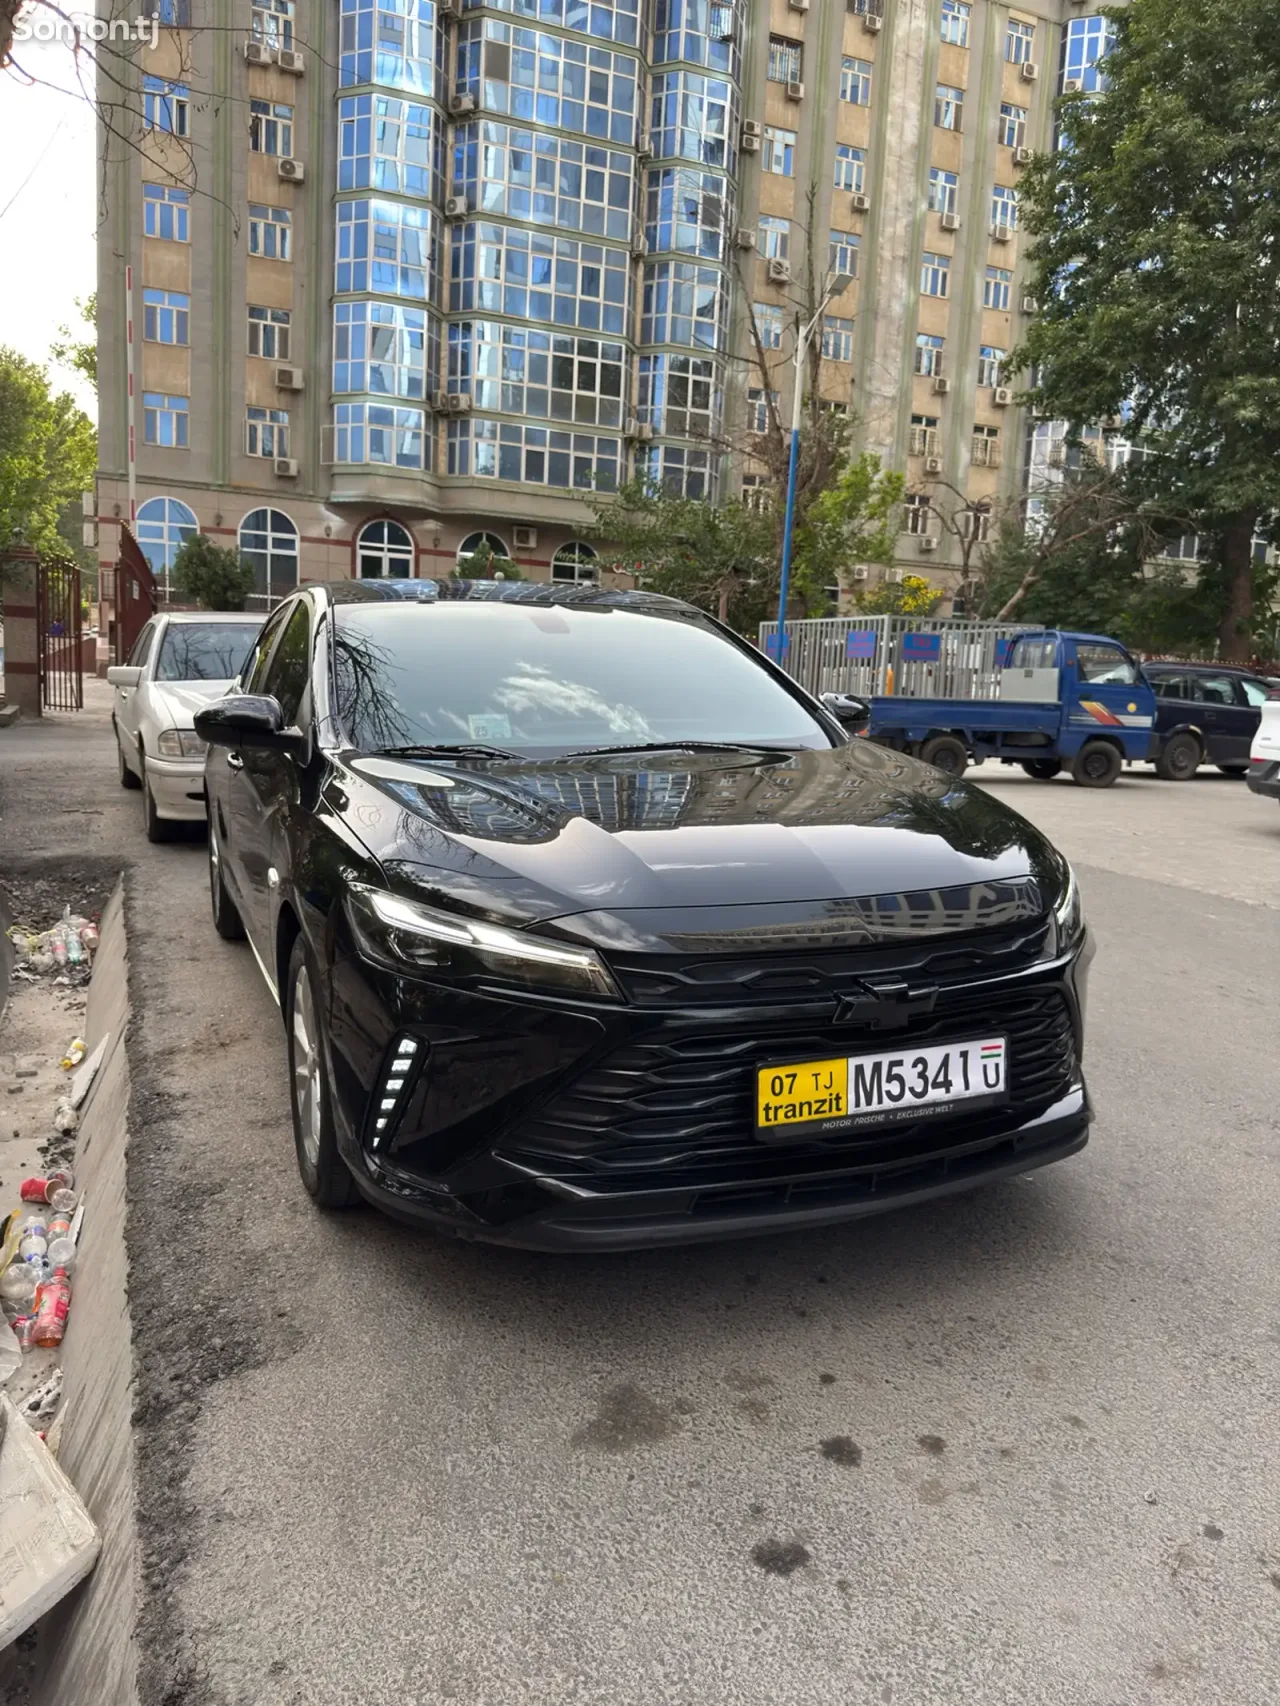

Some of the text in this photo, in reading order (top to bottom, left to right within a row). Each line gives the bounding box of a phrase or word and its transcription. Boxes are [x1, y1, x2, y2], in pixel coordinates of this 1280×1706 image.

[770, 1071, 834, 1097] 07 TJ
[854, 1049, 970, 1109] M5341
[982, 1062, 1001, 1089] U
[763, 1092, 843, 1122] tranzit
[822, 1119, 852, 1130] MOTOR
[896, 1106, 934, 1120] EXCLUSIVE
[934, 1104, 954, 1114] WELT
